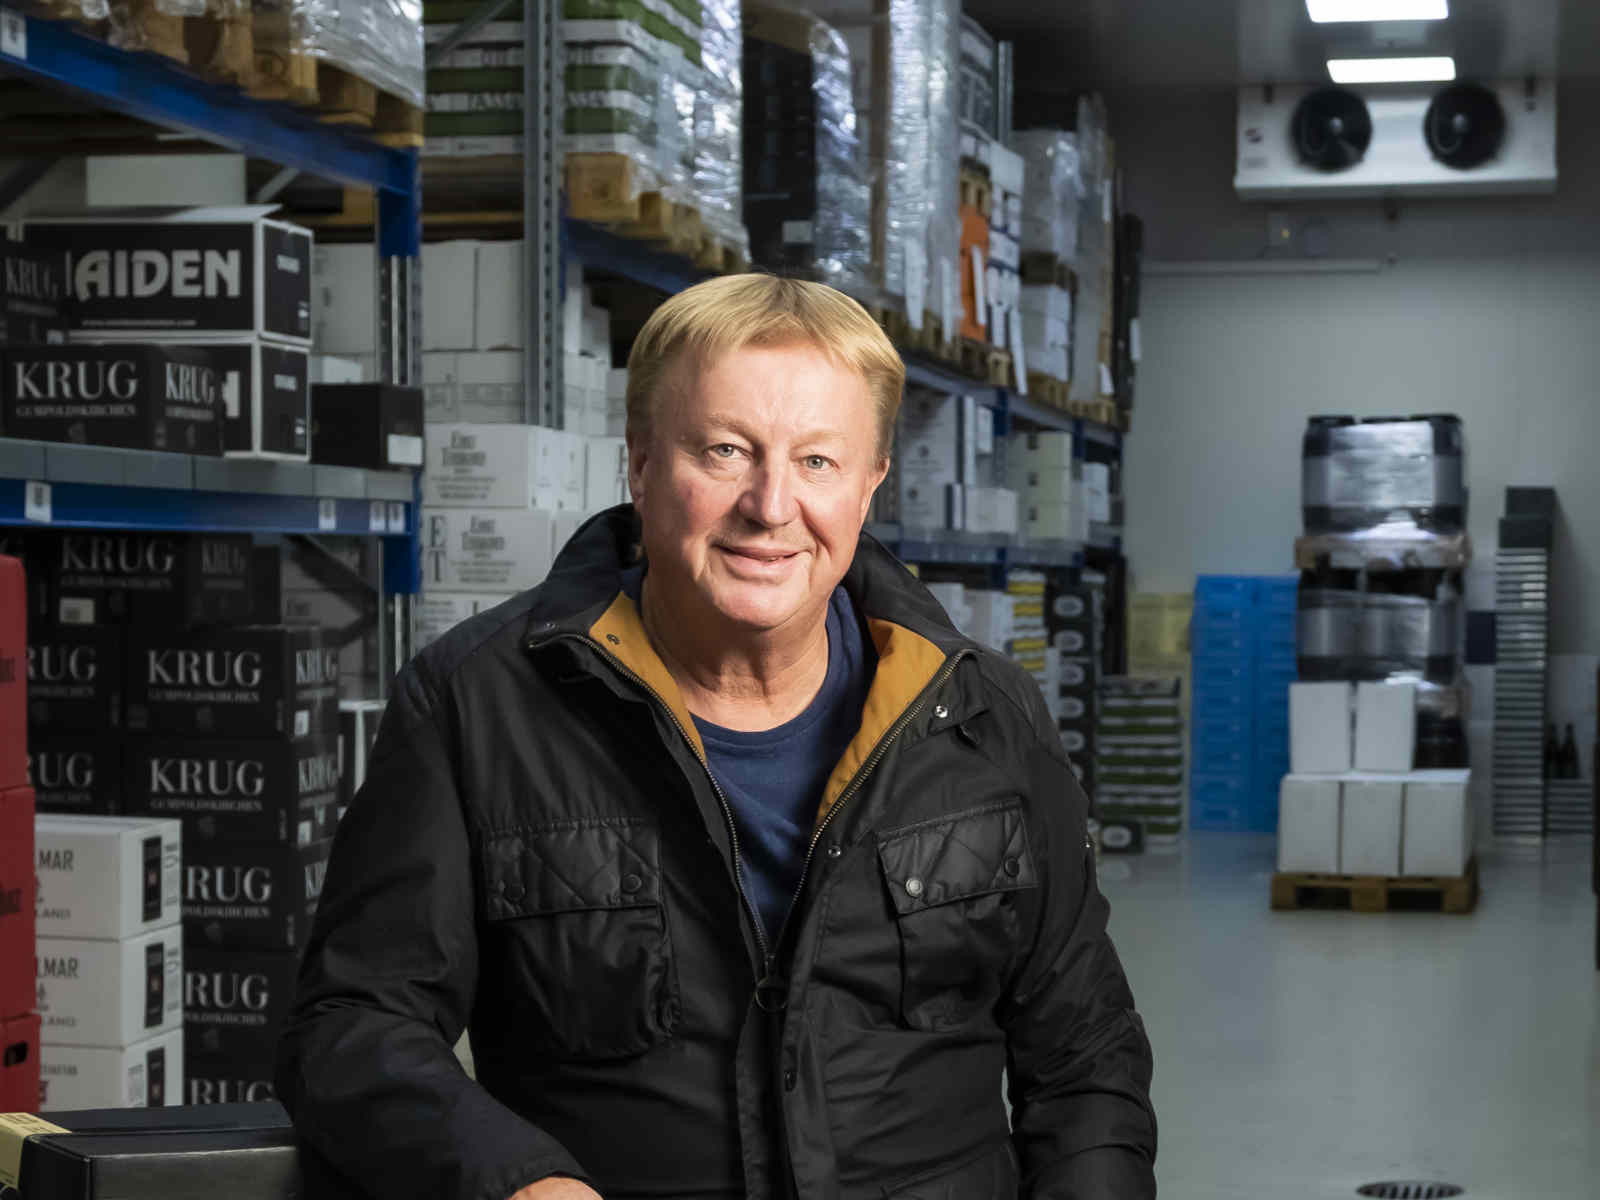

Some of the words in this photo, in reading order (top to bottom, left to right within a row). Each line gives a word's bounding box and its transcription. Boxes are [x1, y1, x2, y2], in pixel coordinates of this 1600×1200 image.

[65, 249, 241, 302] AIDEN
[14, 360, 139, 400] KRUG
[164, 361, 215, 405] KRUG
[61, 535, 175, 574] KRUG
[27, 644, 97, 682] RUG
[147, 650, 262, 688] KRUG
[149, 758, 265, 796] KRUG
[38, 849, 74, 873] MAR
[184, 865, 273, 902] RUG
[183, 972, 269, 1010] RUG
[189, 1078, 275, 1104] RUG
